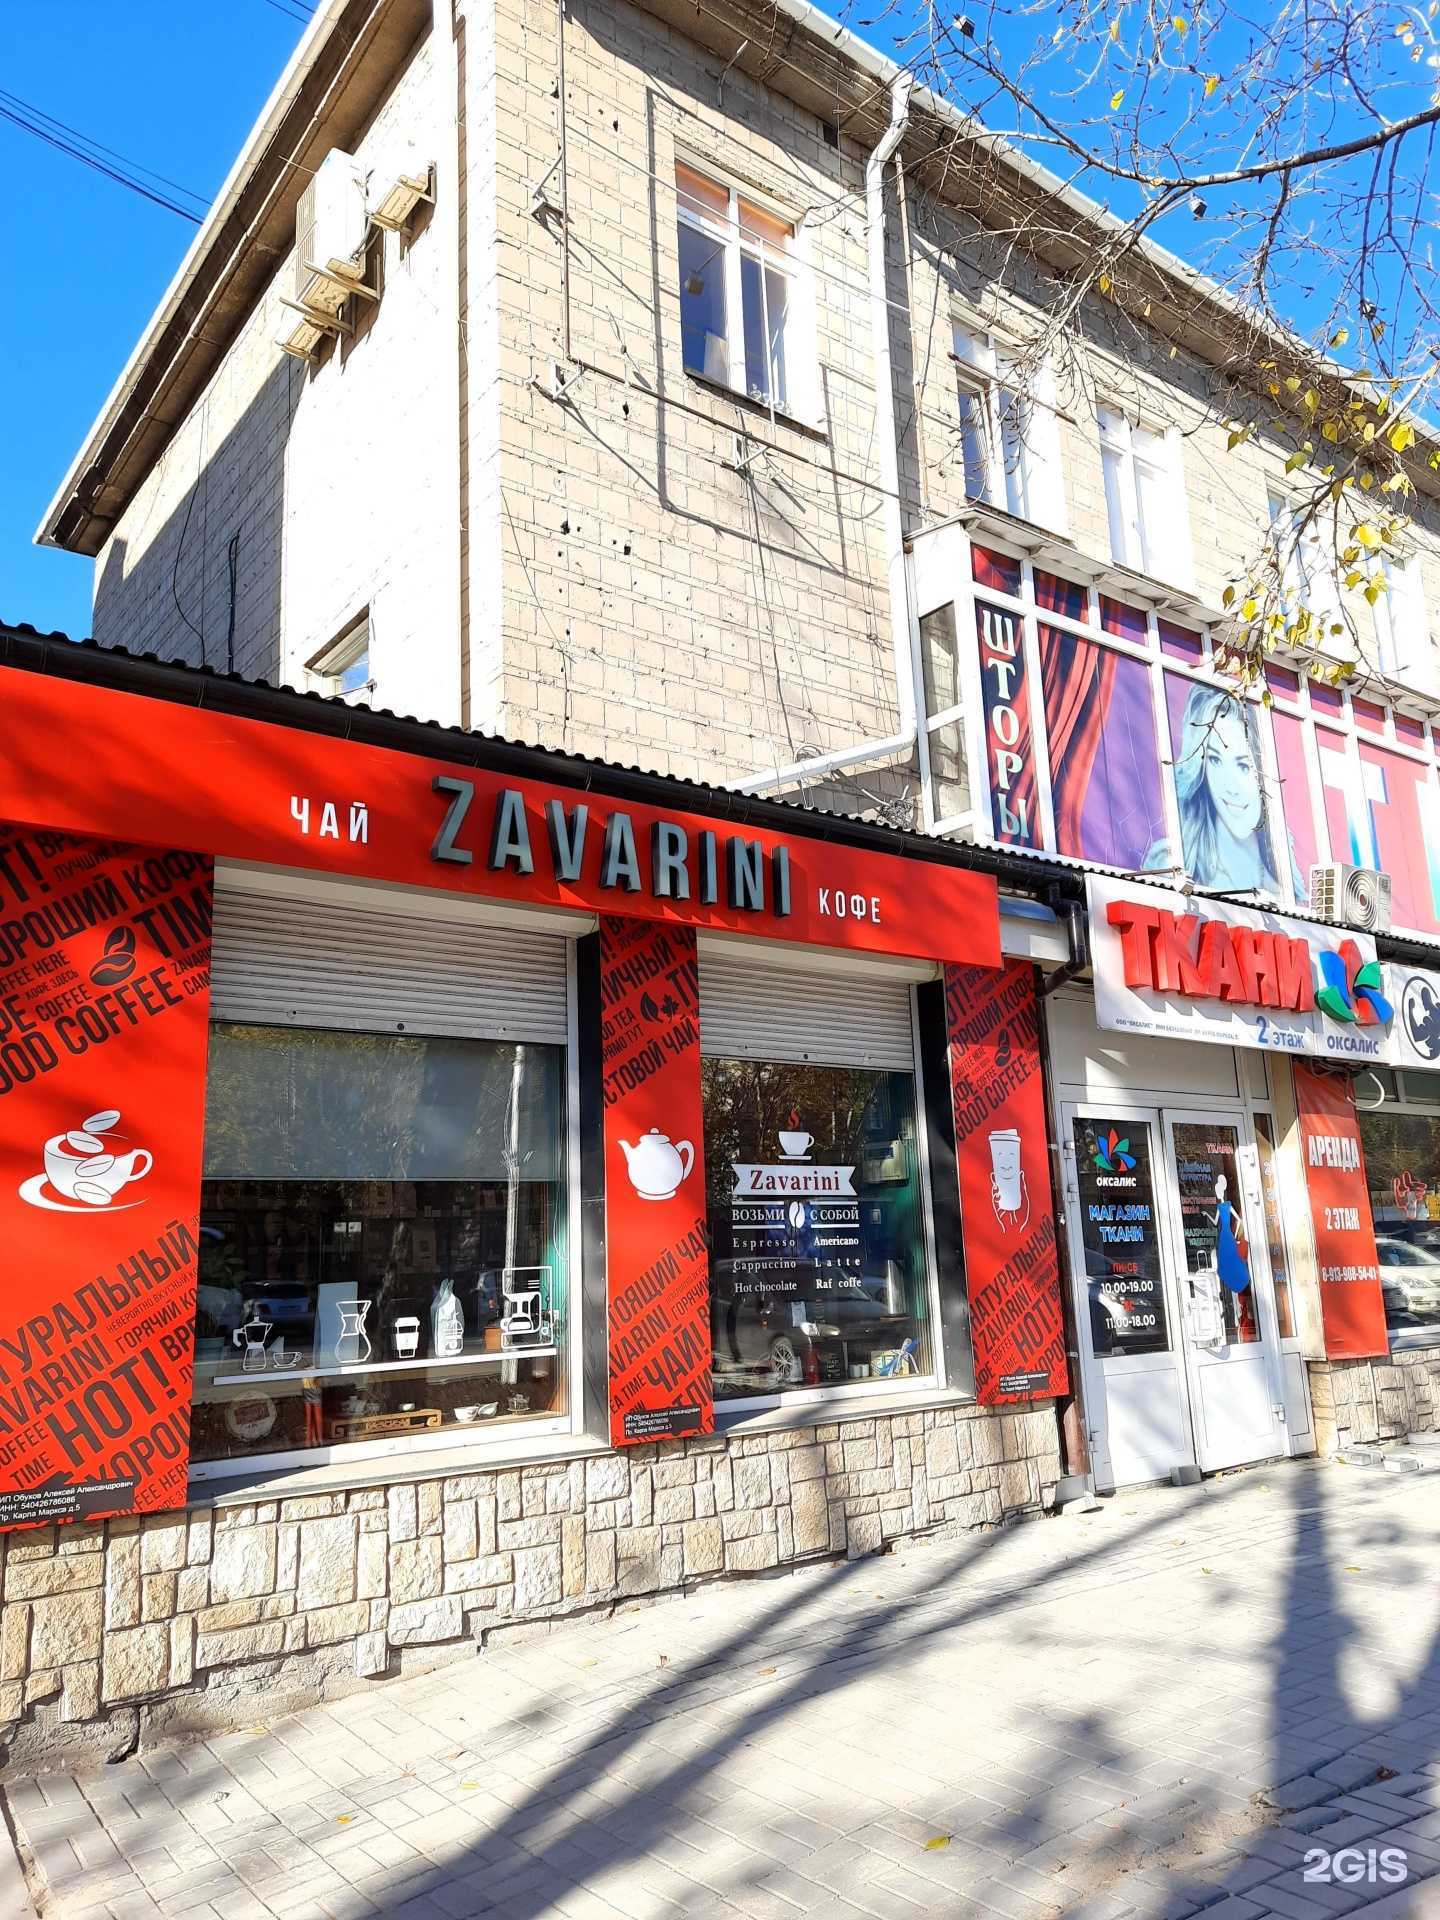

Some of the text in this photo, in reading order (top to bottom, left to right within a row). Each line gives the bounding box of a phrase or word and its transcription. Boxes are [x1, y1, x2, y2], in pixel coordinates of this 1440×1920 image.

[982, 609, 1030, 840] ШТОРЫ
[290, 796, 369, 845] ЧАЙ
[430, 775, 792, 917] ZAVARINI
[819, 886, 882, 924] КОФЕ
[1106, 899, 1315, 1014] ТКАНИ
[35, 984, 93, 1022] COFFEE
[54, 968, 184, 1055] COFFEE
[613, 1006, 636, 1031] TEA
[661, 1013, 700, 1056] ЧАЙ
[1256, 1015, 1269, 1044] 2
[1326, 1033, 1380, 1055] ОКСАЛИС
[985, 1054, 1032, 1110] COFFEE
[1308, 1135, 1361, 1173] АРЕНДА
[750, 1170, 841, 1191] Zavarini
[731, 1206, 860, 1221] ВОЗЬМИ С СОБОЙ
[1088, 1204, 1151, 1221] МАГАЗИН
[1324, 1207, 1361, 1231] 2 ЭТАЖ
[733, 1237, 796, 1251] Espresso
[814, 1235, 859, 1246] Americano
[1099, 1225, 1144, 1243] ТКАНИ
[733, 1258, 797, 1273] Cappuccino
[814, 1257, 861, 1268] Latte
[0, 1219, 199, 1385] УРАЛЬНЫЙ
[734, 1280, 798, 1293] Hot chocolate
[815, 1276, 862, 1290] Raf coffe
[1101, 1280, 1154, 1294] 10.00-19.00
[115, 1299, 182, 1356] ГОРЯЧИЙ
[978, 1283, 1032, 1355] ZAVARINI
[1011, 1294, 1059, 1364] HOT!
[1105, 1314, 1156, 1329] 11.00-18.00
[643, 1321, 711, 1393] ЧАЙ!
[621, 1372, 647, 1401] TIME
[44, 1347, 178, 1469] HOT!
[9, 1451, 55, 1489] TIME
[43, 1487, 76, 1499] Алексей
[12, 1510, 37, 1521] Карла
[38, 1507, 67, 1517] Маркса
